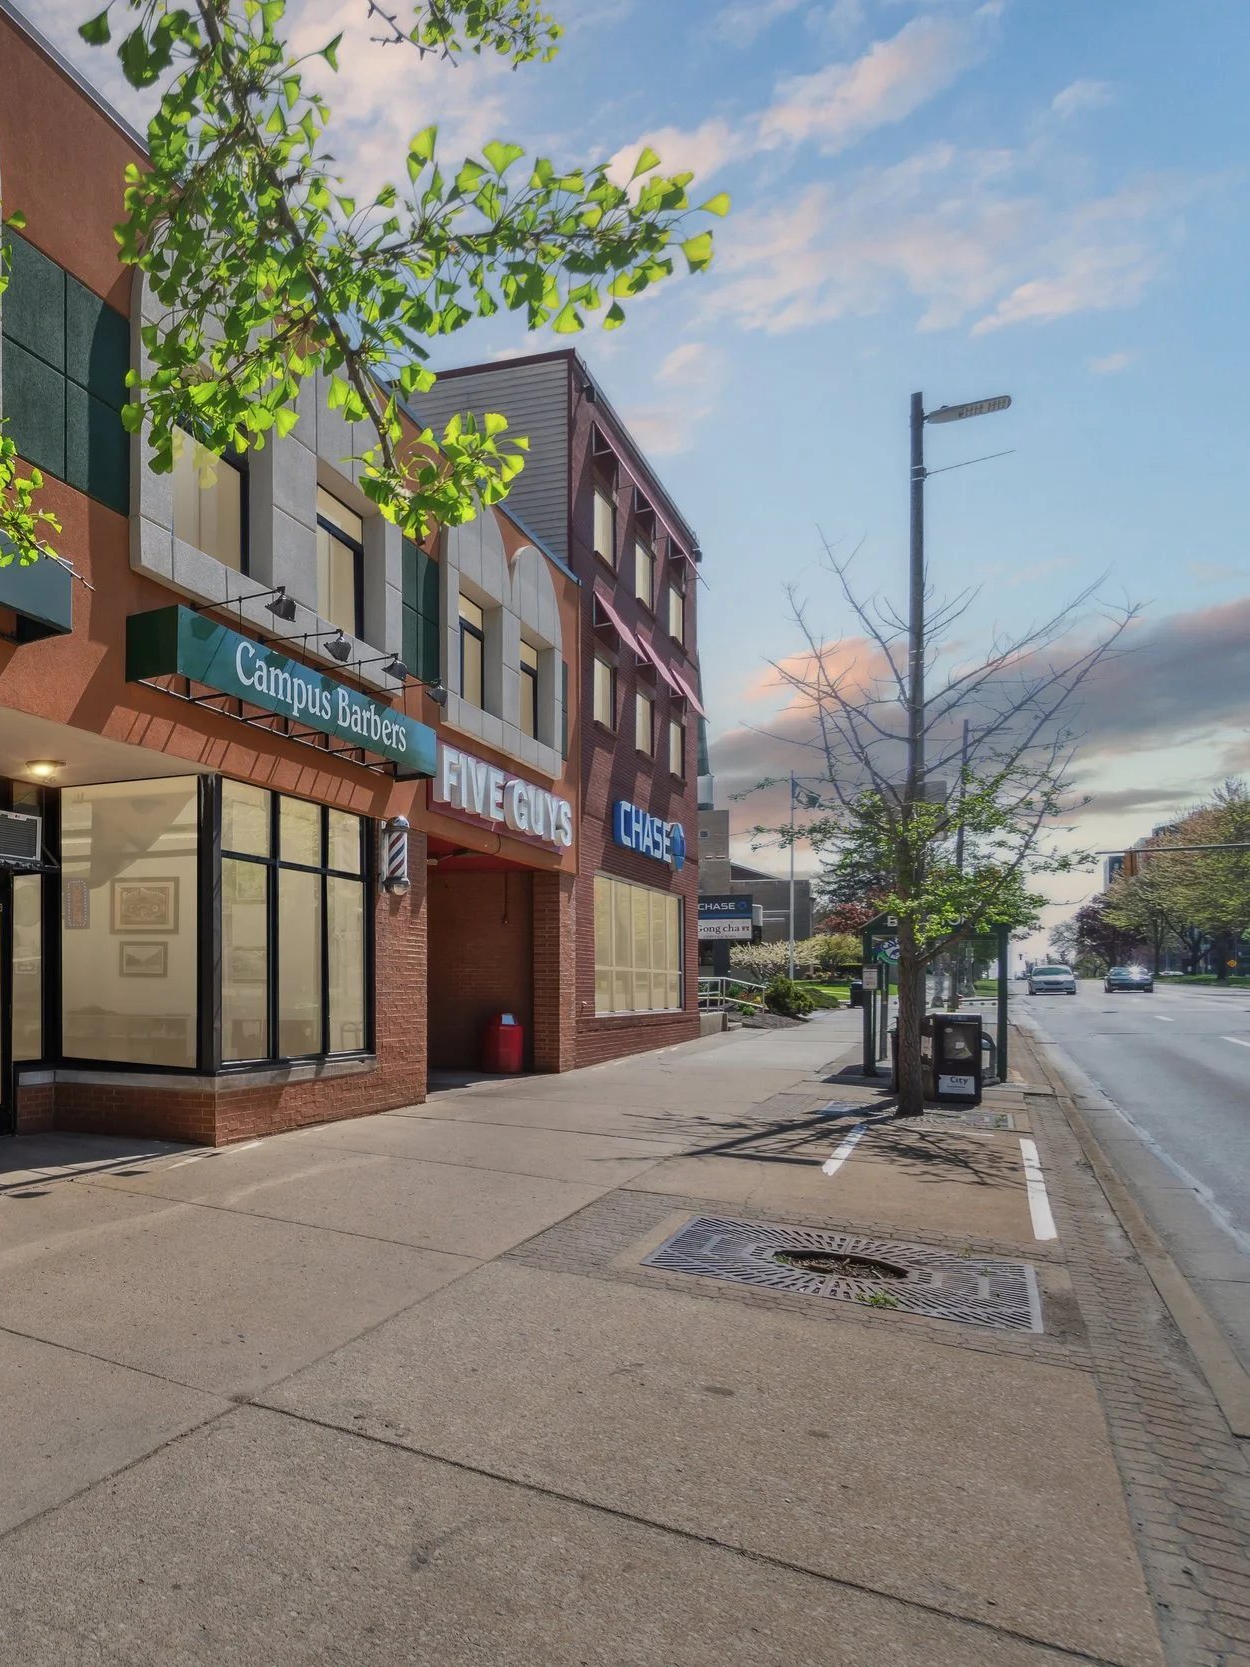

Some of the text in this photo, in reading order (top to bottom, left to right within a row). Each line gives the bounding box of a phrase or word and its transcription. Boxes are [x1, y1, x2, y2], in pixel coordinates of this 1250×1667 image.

[236, 641, 407, 752] Campus Barbers
[434, 744, 572, 847] FIVE GUYS
[620, 800, 672, 864] CHASE
[697, 902, 736, 911] CHASE
[723, 924, 740, 932] cha
[950, 1076, 968, 1085] City
